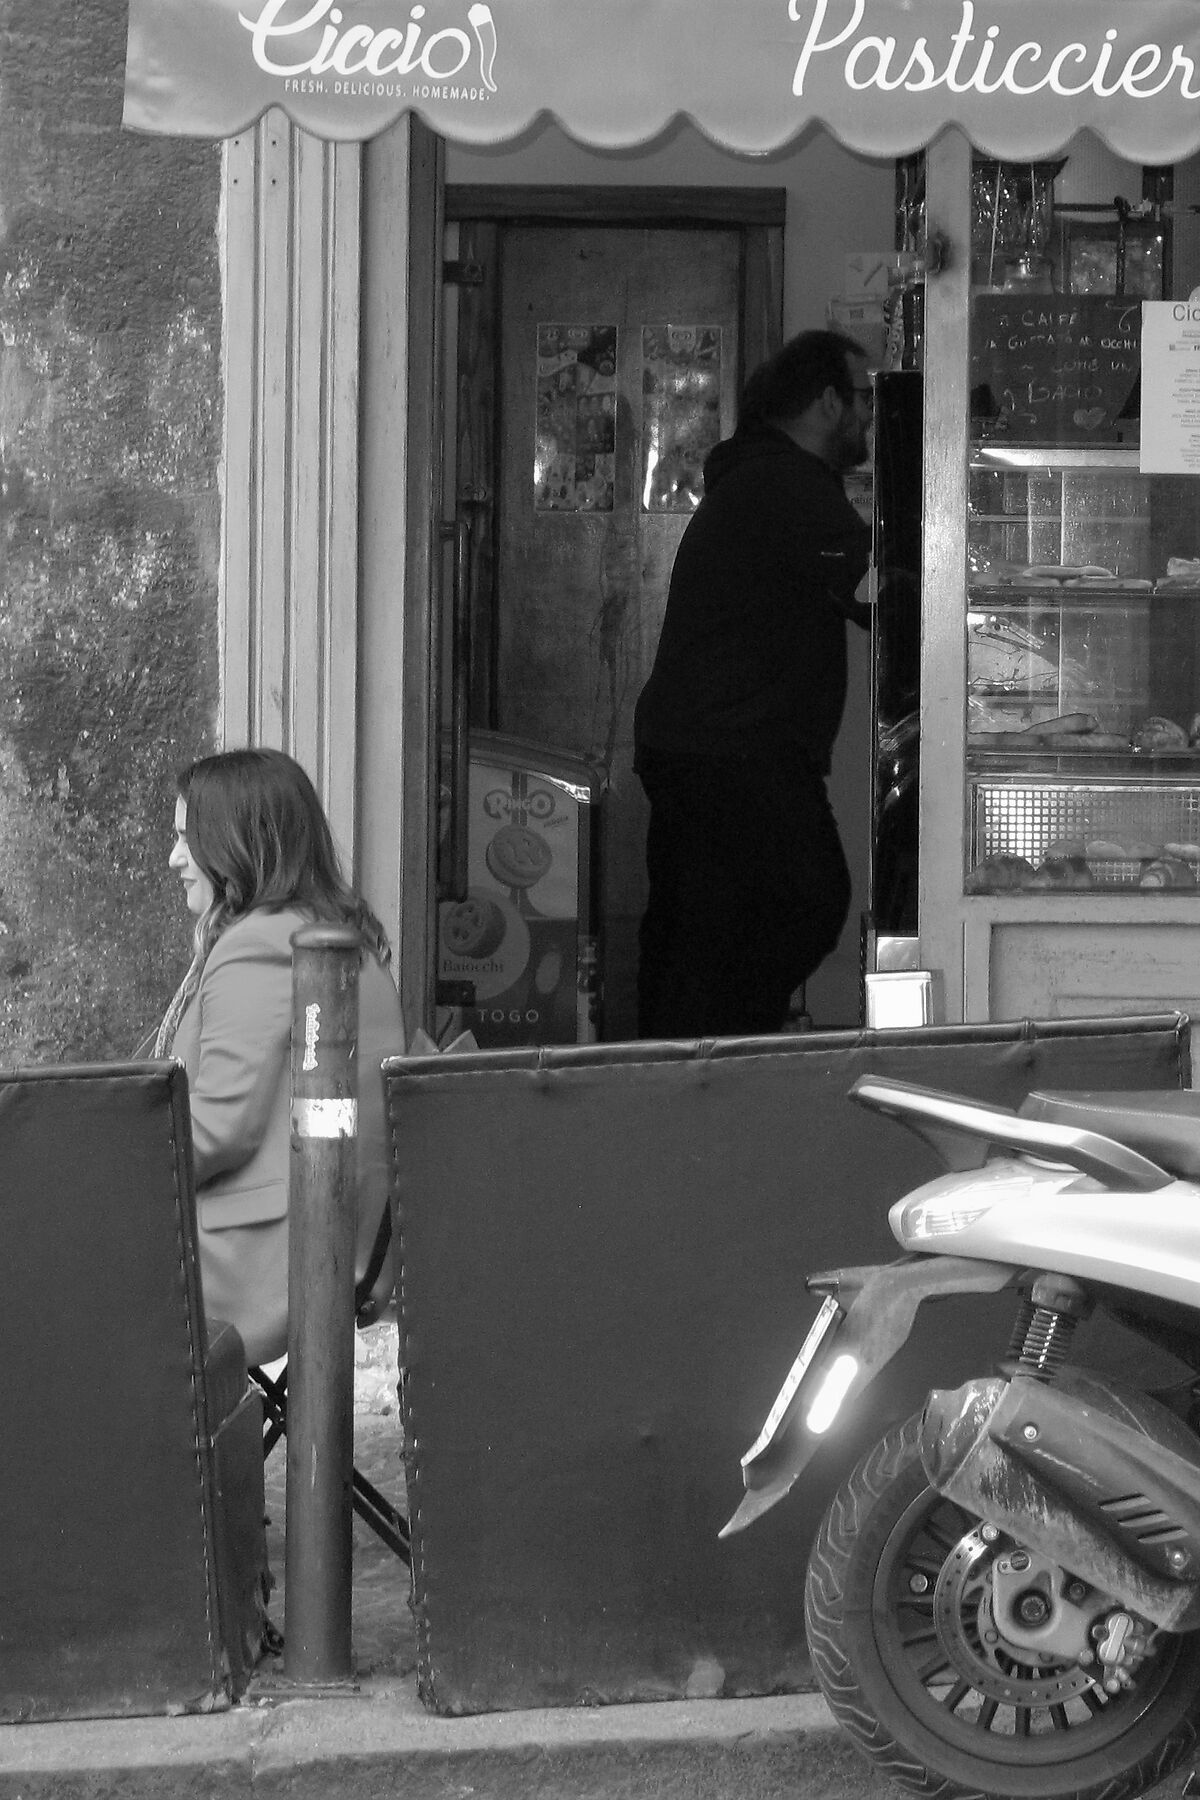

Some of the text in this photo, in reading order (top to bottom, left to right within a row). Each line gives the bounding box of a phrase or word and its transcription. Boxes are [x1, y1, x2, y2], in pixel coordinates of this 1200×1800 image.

[284, 79, 491, 101] FRESH. DELICIOUS. HOMEMADE.
[477, 1009, 540, 1024] TOGO
